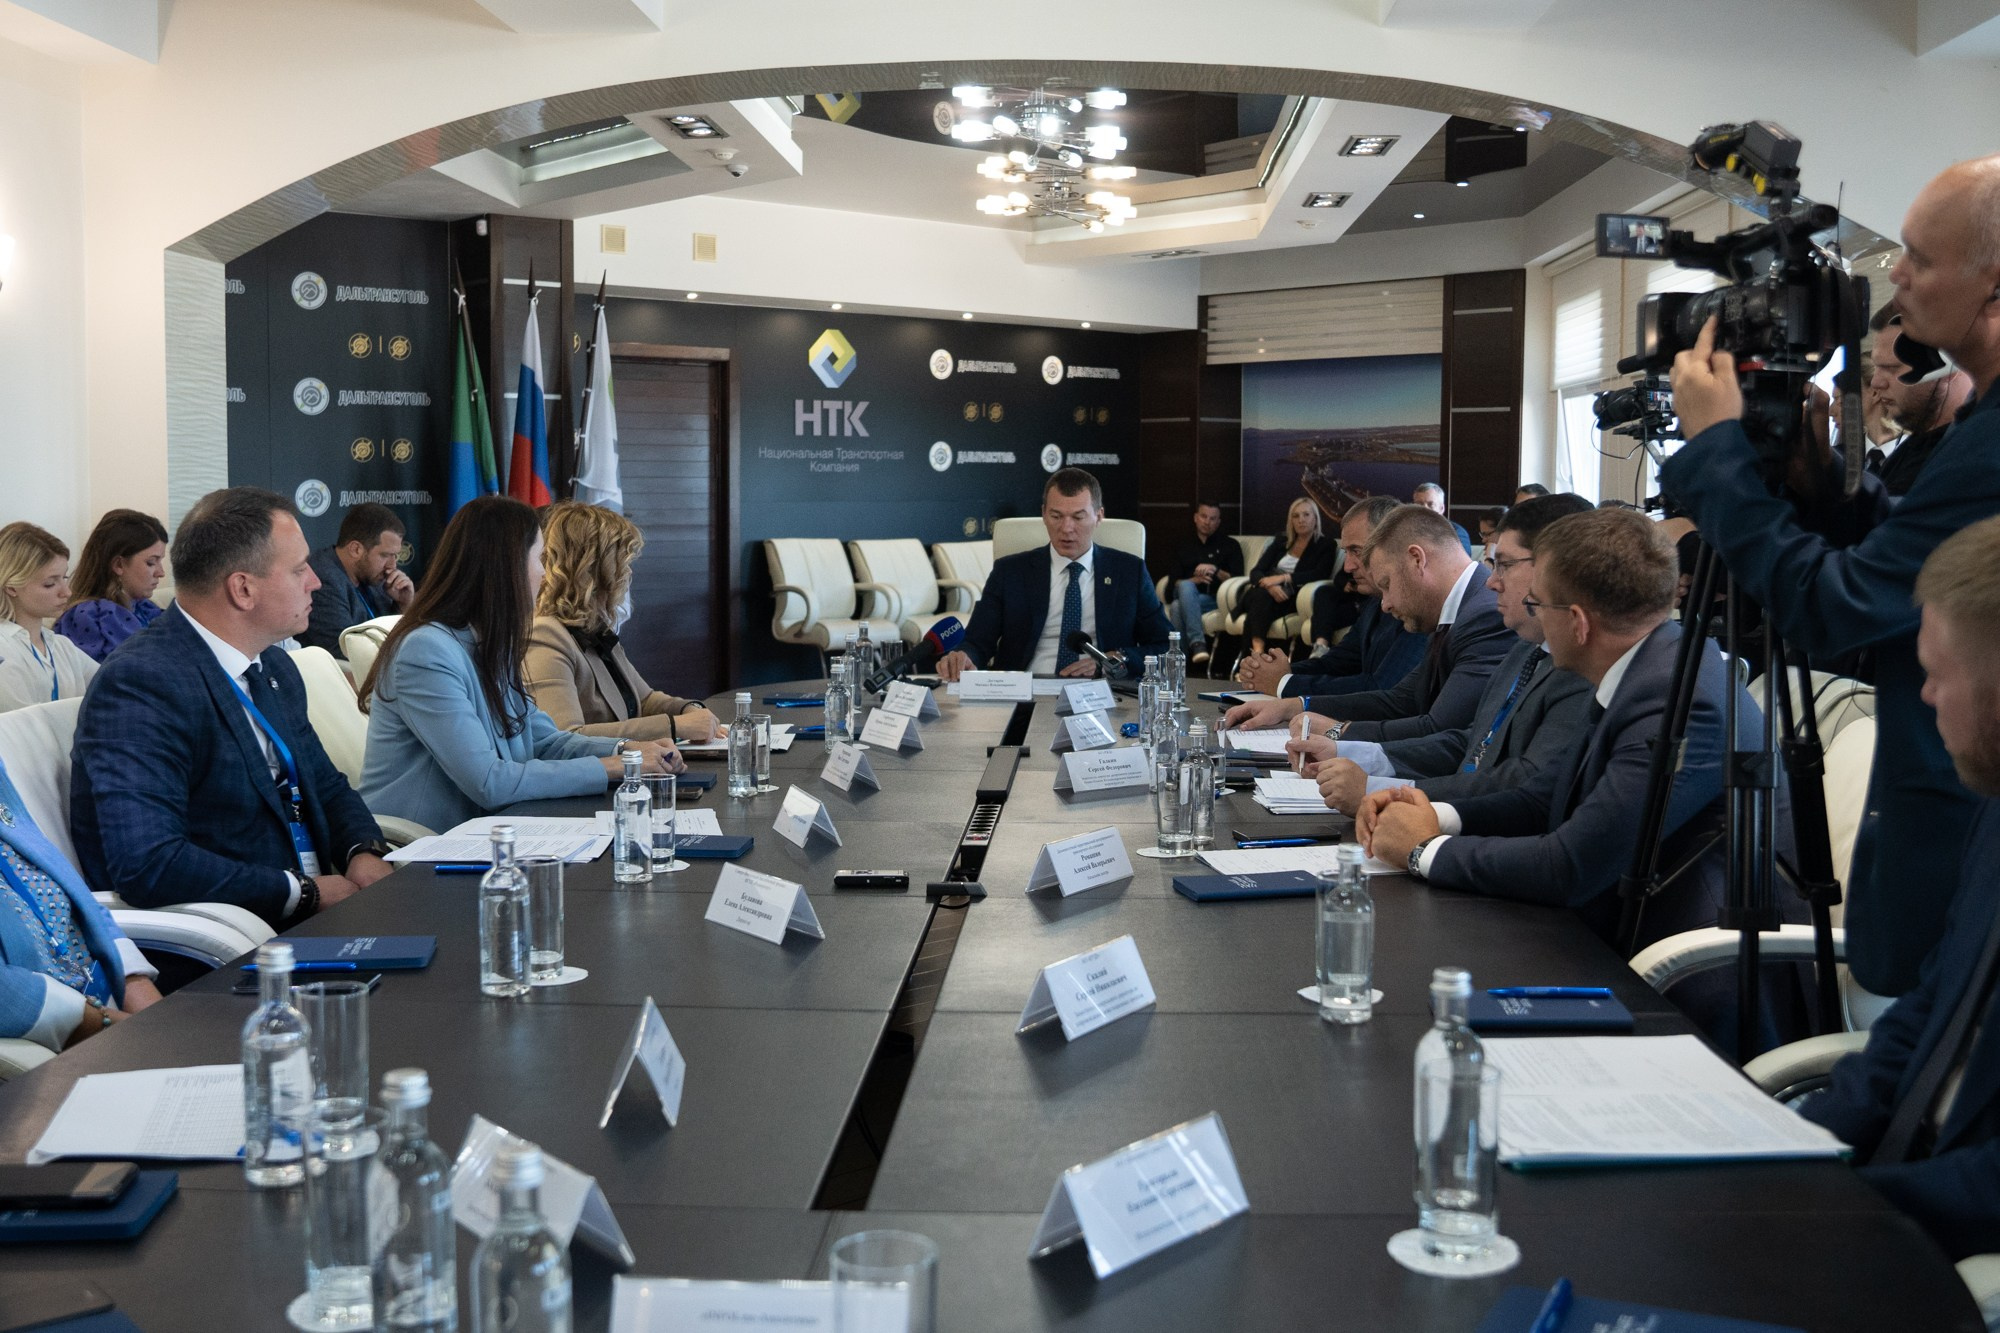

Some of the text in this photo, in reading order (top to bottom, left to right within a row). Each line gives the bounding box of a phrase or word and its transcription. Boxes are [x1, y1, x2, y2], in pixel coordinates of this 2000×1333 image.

[336, 285, 429, 304] ДАЛЬТРАНСУГОЛЬ
[338, 390, 431, 407] ДАЛЬТРАНСУГОЛЬ
[794, 399, 870, 437] НТК
[758, 446, 905, 461] Национальная Транспортная
[810, 461, 860, 472] Компания
